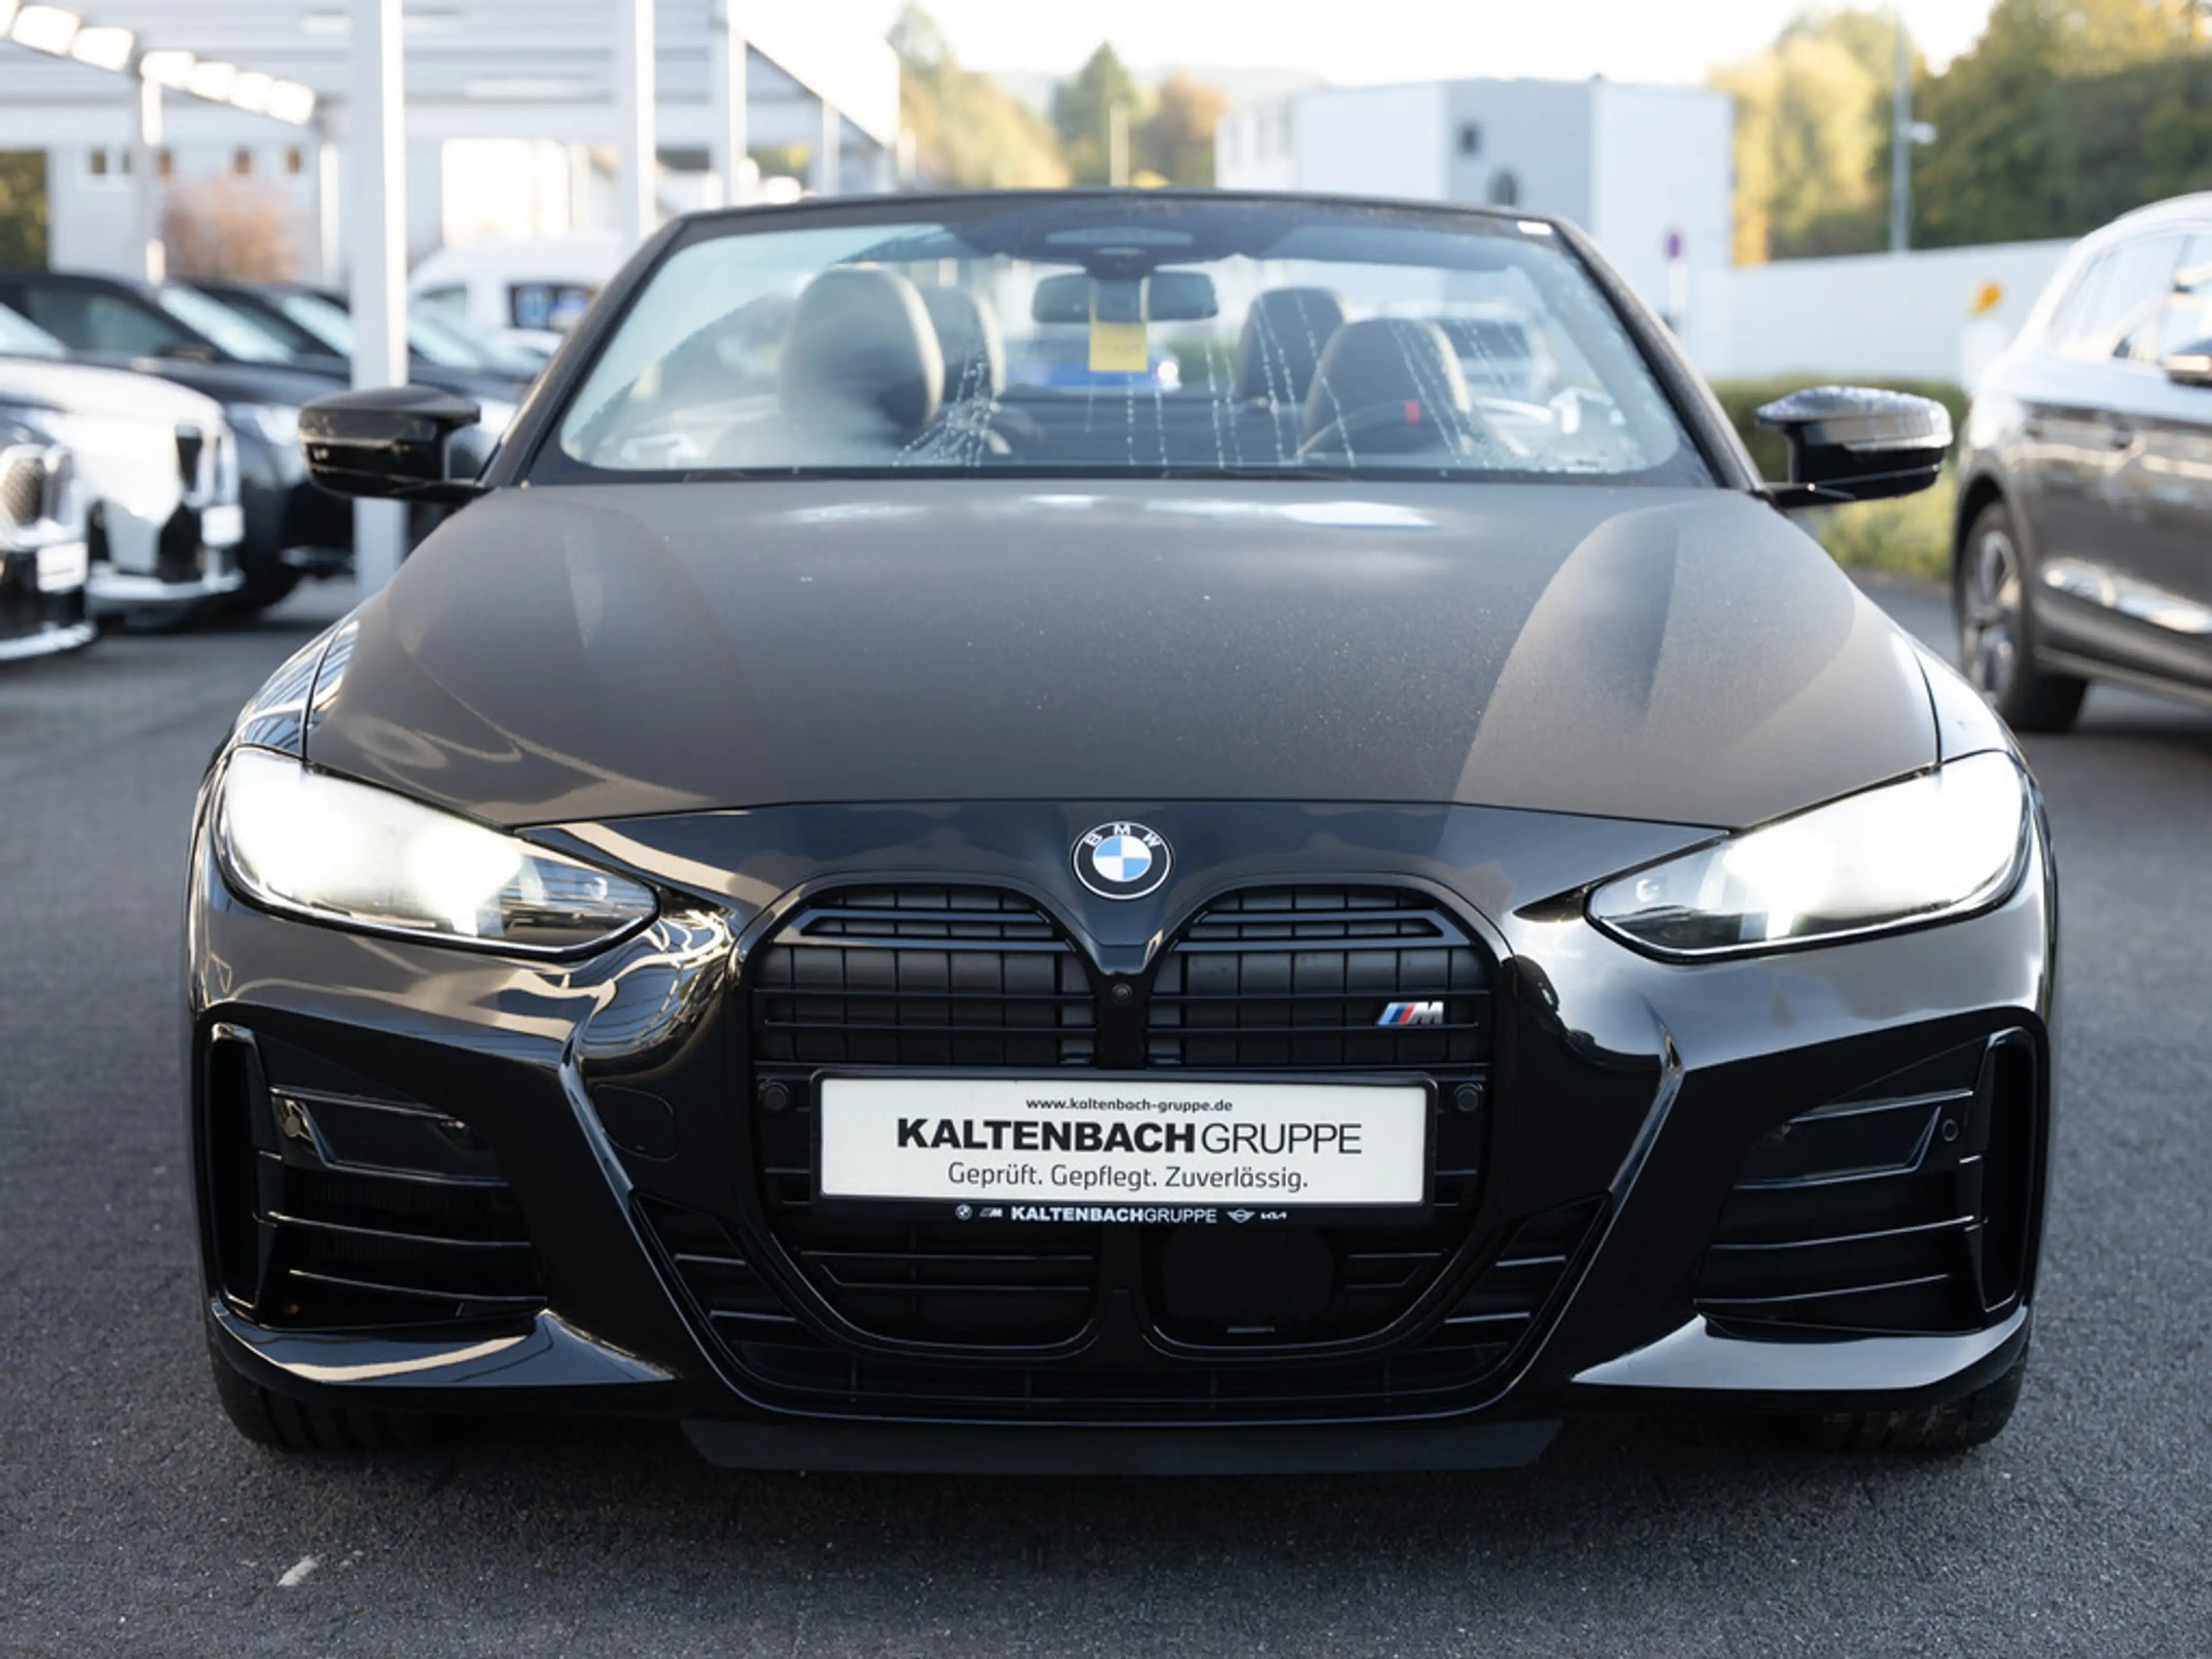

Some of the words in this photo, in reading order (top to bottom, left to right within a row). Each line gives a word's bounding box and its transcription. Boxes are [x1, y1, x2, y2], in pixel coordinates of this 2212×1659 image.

[1083, 823, 1162, 847] BMW
[1026, 1097, 1233, 1113] www.kaltenbach-gruppe.de
[948, 1162, 1043, 1188] Geprüft.
[1051, 1164, 1157, 1192] Gepflegt.
[1165, 1166, 1308, 1193] Zuverlässig.
